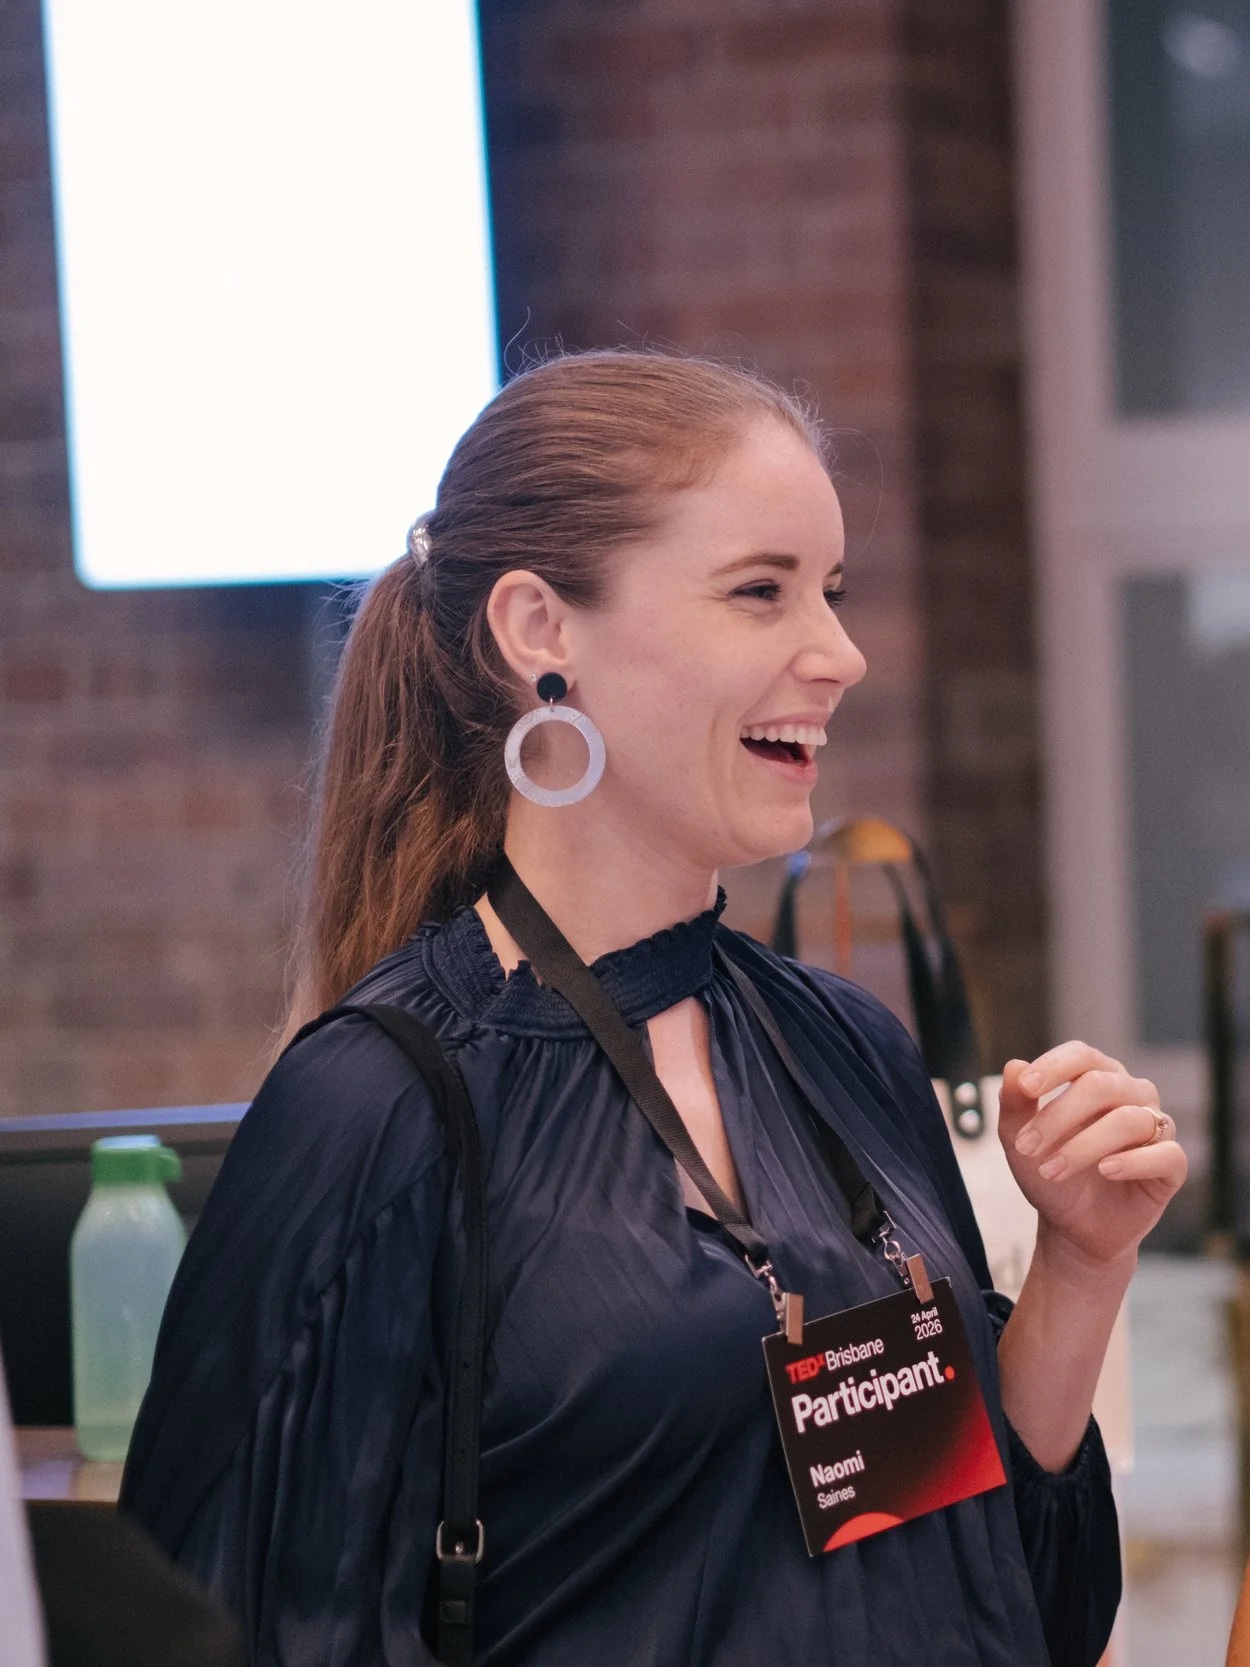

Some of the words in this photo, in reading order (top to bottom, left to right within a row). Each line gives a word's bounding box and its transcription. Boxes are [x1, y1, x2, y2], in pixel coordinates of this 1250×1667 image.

[911, 1313, 921, 1324] 24
[921, 1306, 938, 1321] April
[914, 1318, 943, 1340] 2026
[791, 1351, 955, 1433] Participant.
[809, 1449, 865, 1488] Naomi
[817, 1485, 856, 1509] Saines
